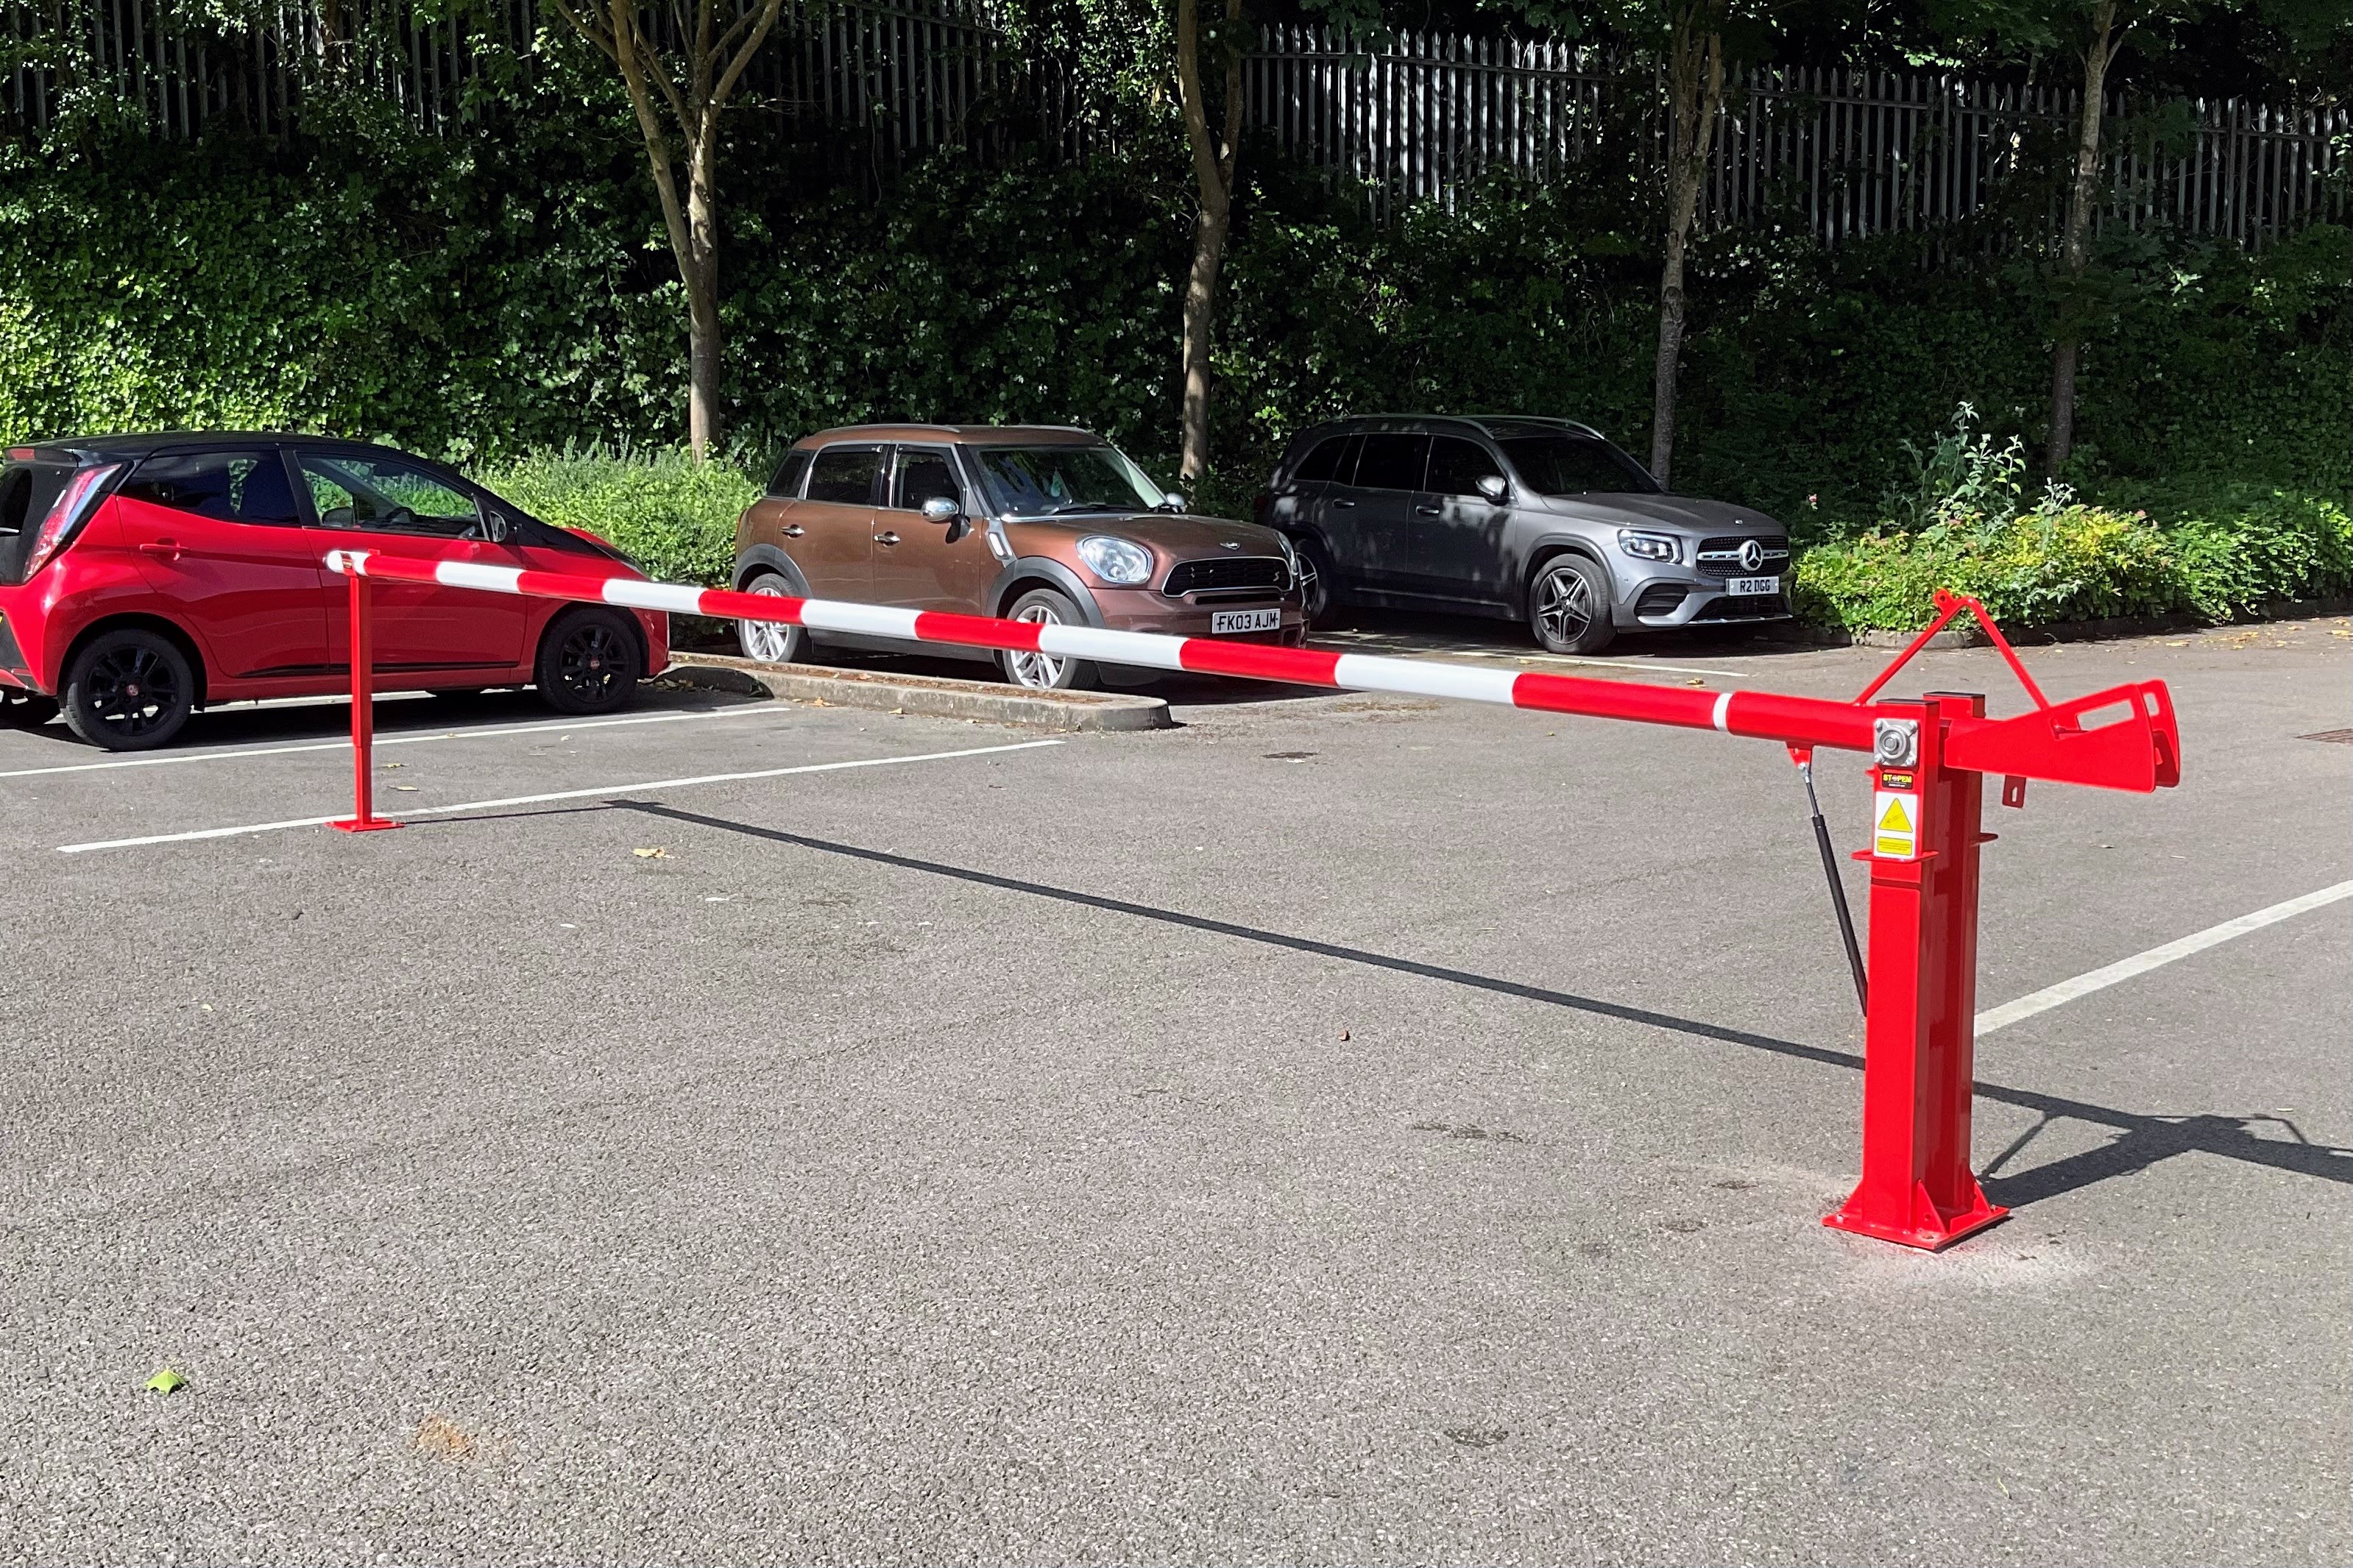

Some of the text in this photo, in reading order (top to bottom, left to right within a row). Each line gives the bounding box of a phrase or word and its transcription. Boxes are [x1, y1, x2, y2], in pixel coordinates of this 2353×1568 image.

[1740, 580, 1752, 592] R2
[1217, 612, 1277, 631] FK03 AJM
